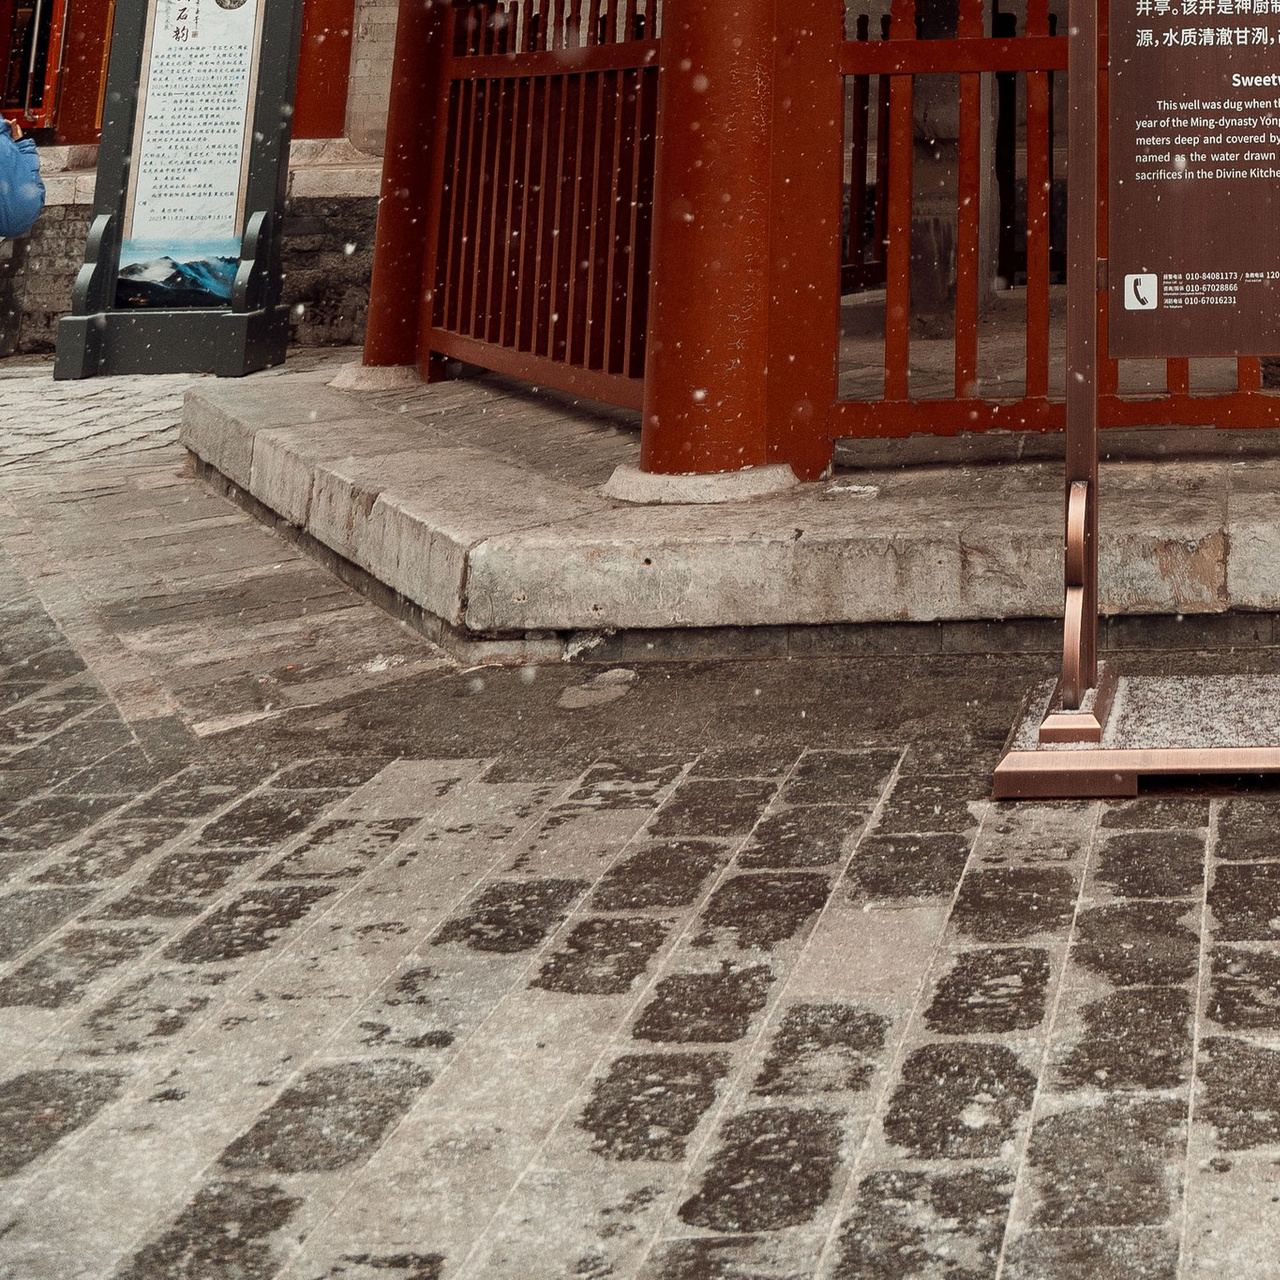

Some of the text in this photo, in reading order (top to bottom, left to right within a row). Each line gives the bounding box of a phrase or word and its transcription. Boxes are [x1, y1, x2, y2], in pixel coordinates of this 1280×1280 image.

[1157, 101, 1177, 110] This
[1179, 100, 1200, 110] well
[1223, 99, 1242, 111] dug
[1244, 99, 1272, 109] when
[1136, 119, 1157, 130] year
[1160, 118, 1170, 127] of
[1172, 118, 1188, 127] the
[1191, 116, 1258, 129] Ming-dynasty
[1136, 136, 1171, 146] meters
[1174, 135, 1199, 146] deep
[1203, 134, 1222, 144] and
[1226, 133, 1266, 143] covered
[1135, 152, 1170, 162] named
[1190, 152, 1206, 161] the
[1211, 152, 1240, 161] water
[1244, 151, 1275, 161] drawn
[1135, 170, 1182, 180] sacrifices
[1185, 169, 1194, 179] in
[1197, 169, 1213, 179] the
[1216, 169, 1247, 178] Divine
[1186, 272, 1237, 280] 010-84081173
[1266, 271, 1280, 279] 120
[1185, 284, 1238, 292] 010-67028866
[1184, 297, 1237, 305] 010-67016231
